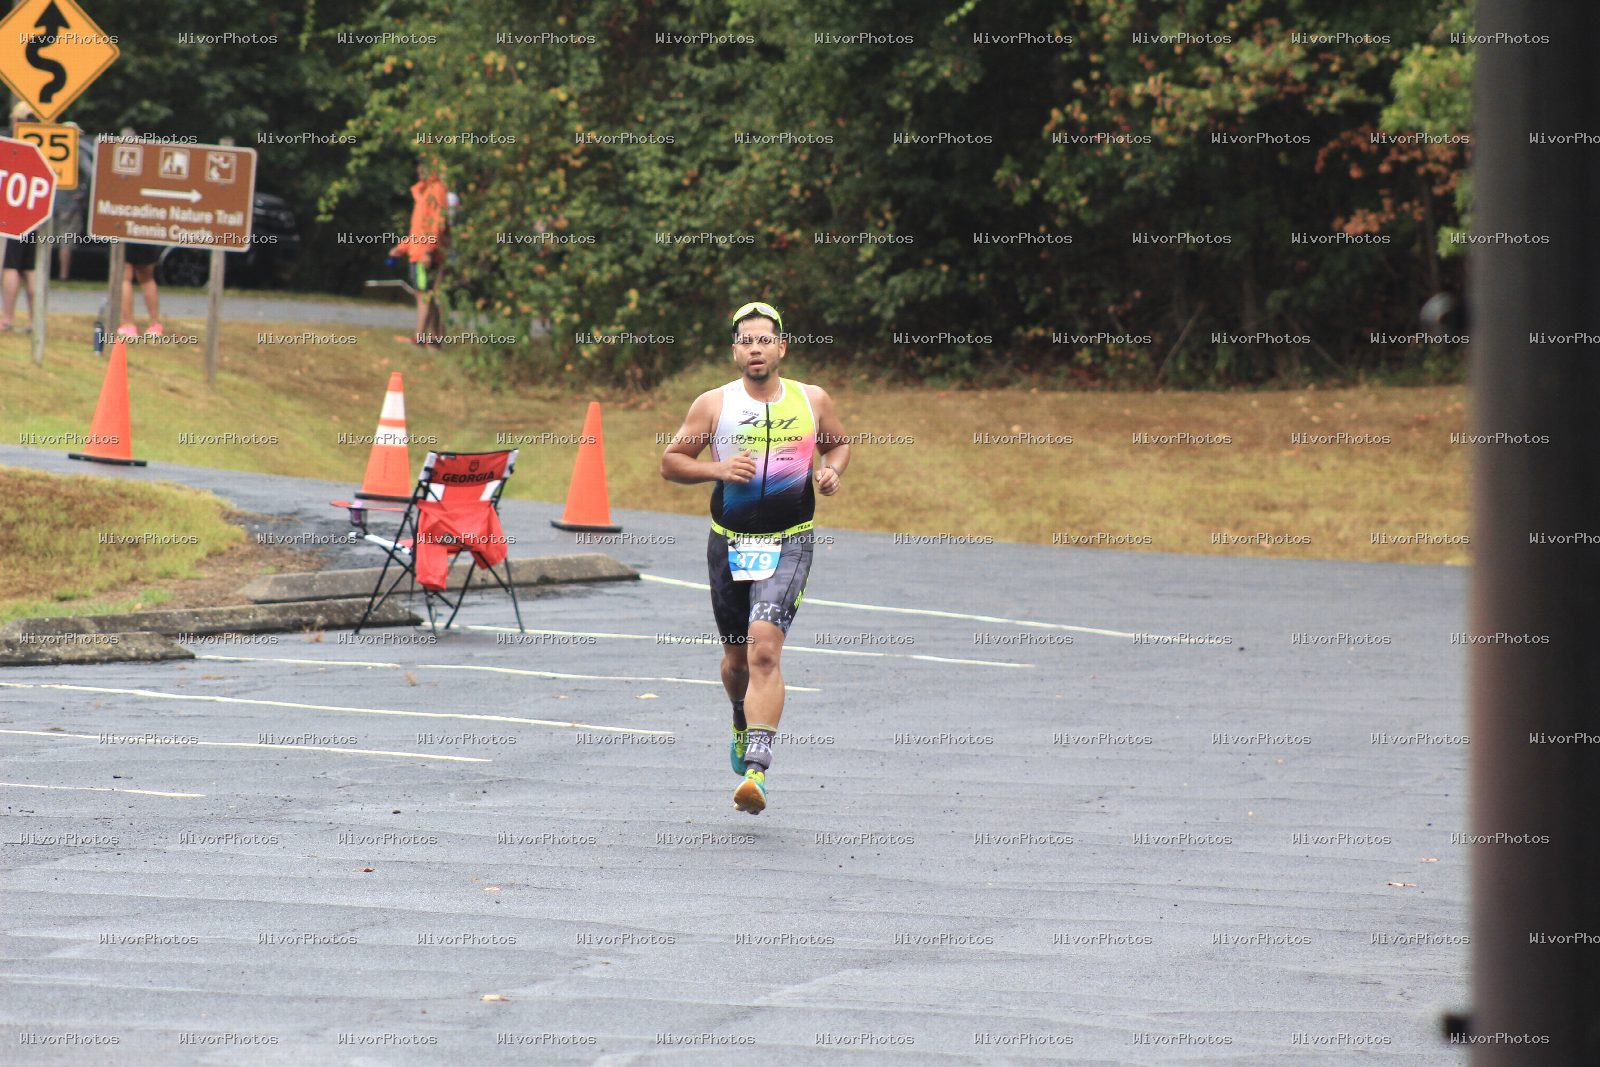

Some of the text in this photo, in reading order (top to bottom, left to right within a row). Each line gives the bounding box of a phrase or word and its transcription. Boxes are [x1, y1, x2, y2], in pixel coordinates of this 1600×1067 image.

[0, 169, 50, 210] TOP
[97, 200, 244, 226] Muscadine Nature Trail
[125, 220, 167, 238] Tennis
[442, 471, 495, 483] GEORGIA
[736, 552, 772, 569] 379
